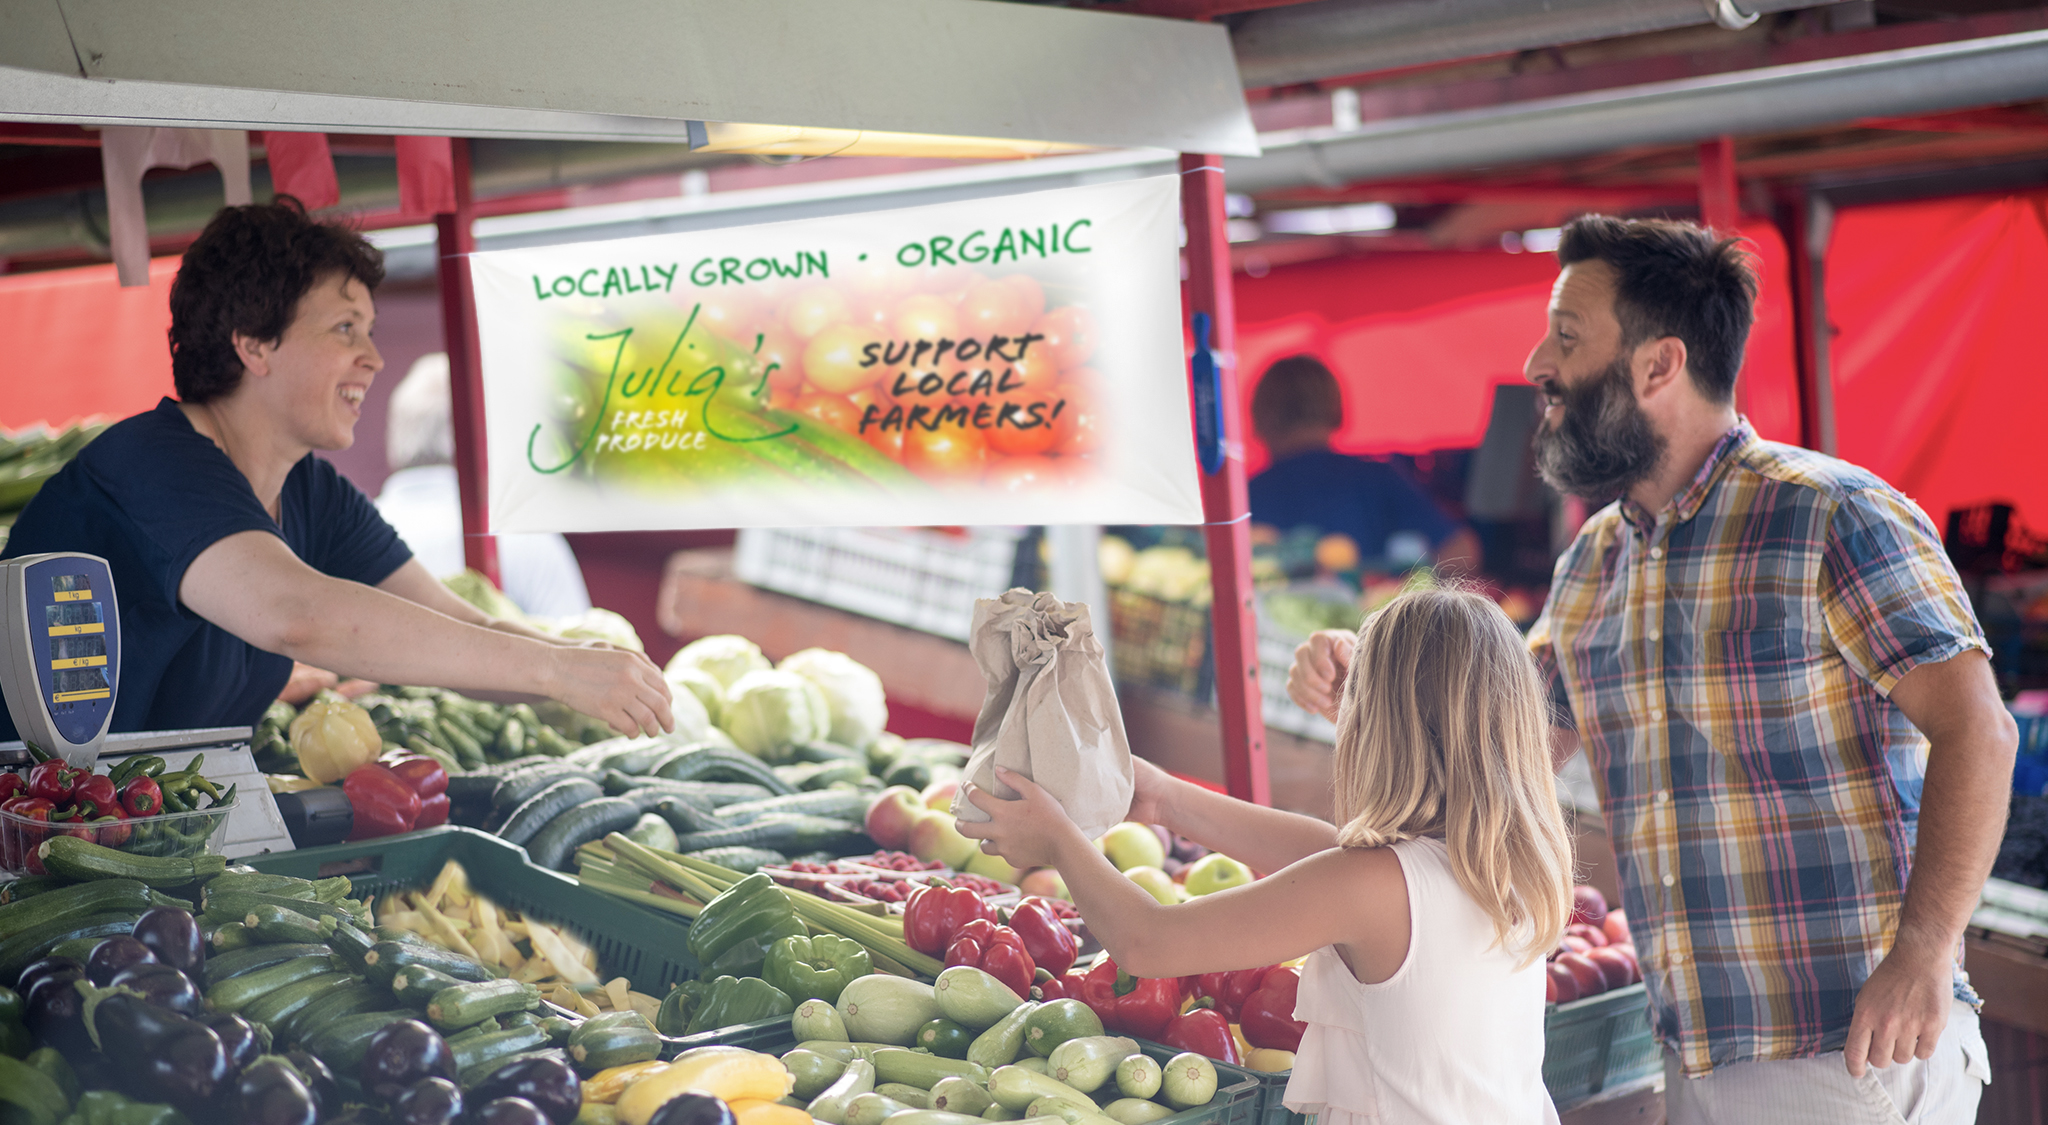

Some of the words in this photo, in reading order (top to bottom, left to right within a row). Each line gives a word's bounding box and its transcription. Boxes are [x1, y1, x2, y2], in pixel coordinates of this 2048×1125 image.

[532, 263, 678, 300] LOCALLY
[690, 250, 830, 287] GROWN
[896, 219, 1092, 267] ORGANIC
[859, 333, 1045, 368] SUPPORT
[527, 302, 800, 475] Julia's
[891, 367, 1026, 398] LOCAL
[611, 410, 689, 431] FRESH
[858, 399, 1066, 435] FARMERS!
[595, 430, 707, 453] PRODUCE
